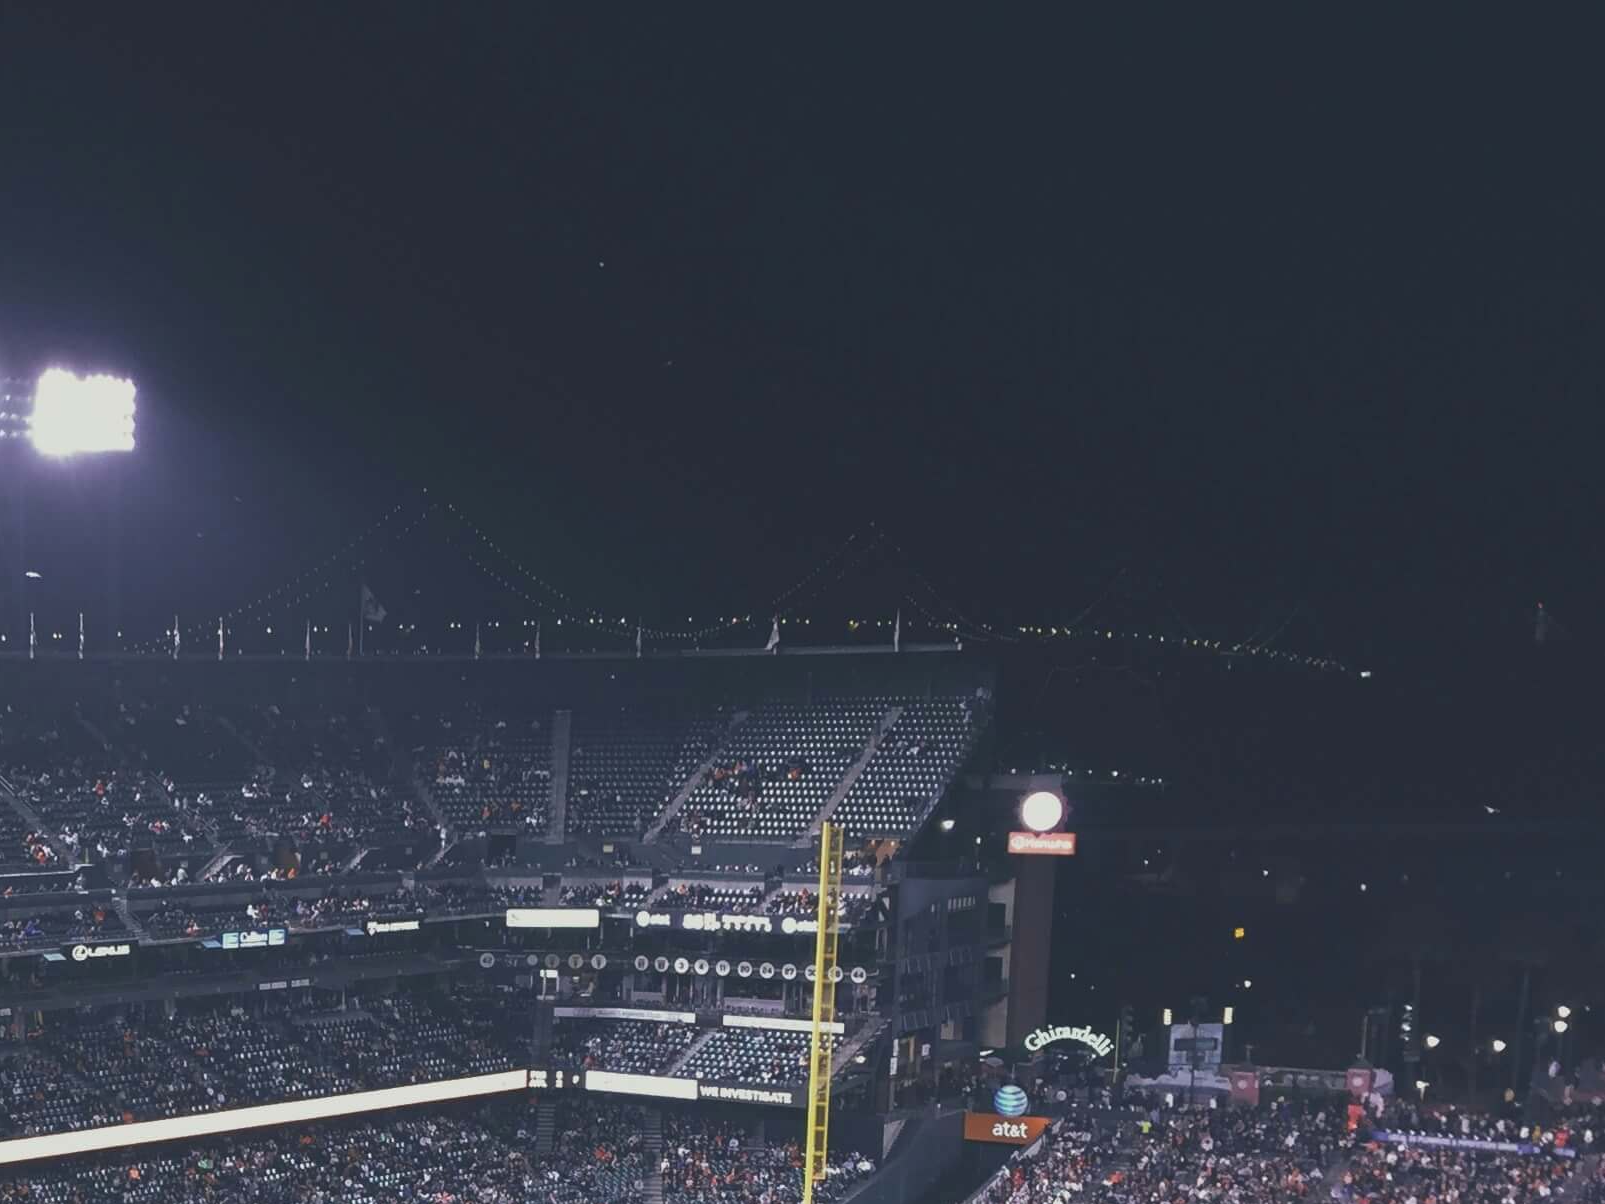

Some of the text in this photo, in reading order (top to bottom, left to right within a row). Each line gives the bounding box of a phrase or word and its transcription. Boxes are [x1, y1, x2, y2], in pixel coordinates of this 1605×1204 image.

[1024, 1024, 1115, 1057] Ghirardelli
[700, 1086, 792, 1104] WE INVESTIGATE
[992, 1122, 1028, 1138] at&t
